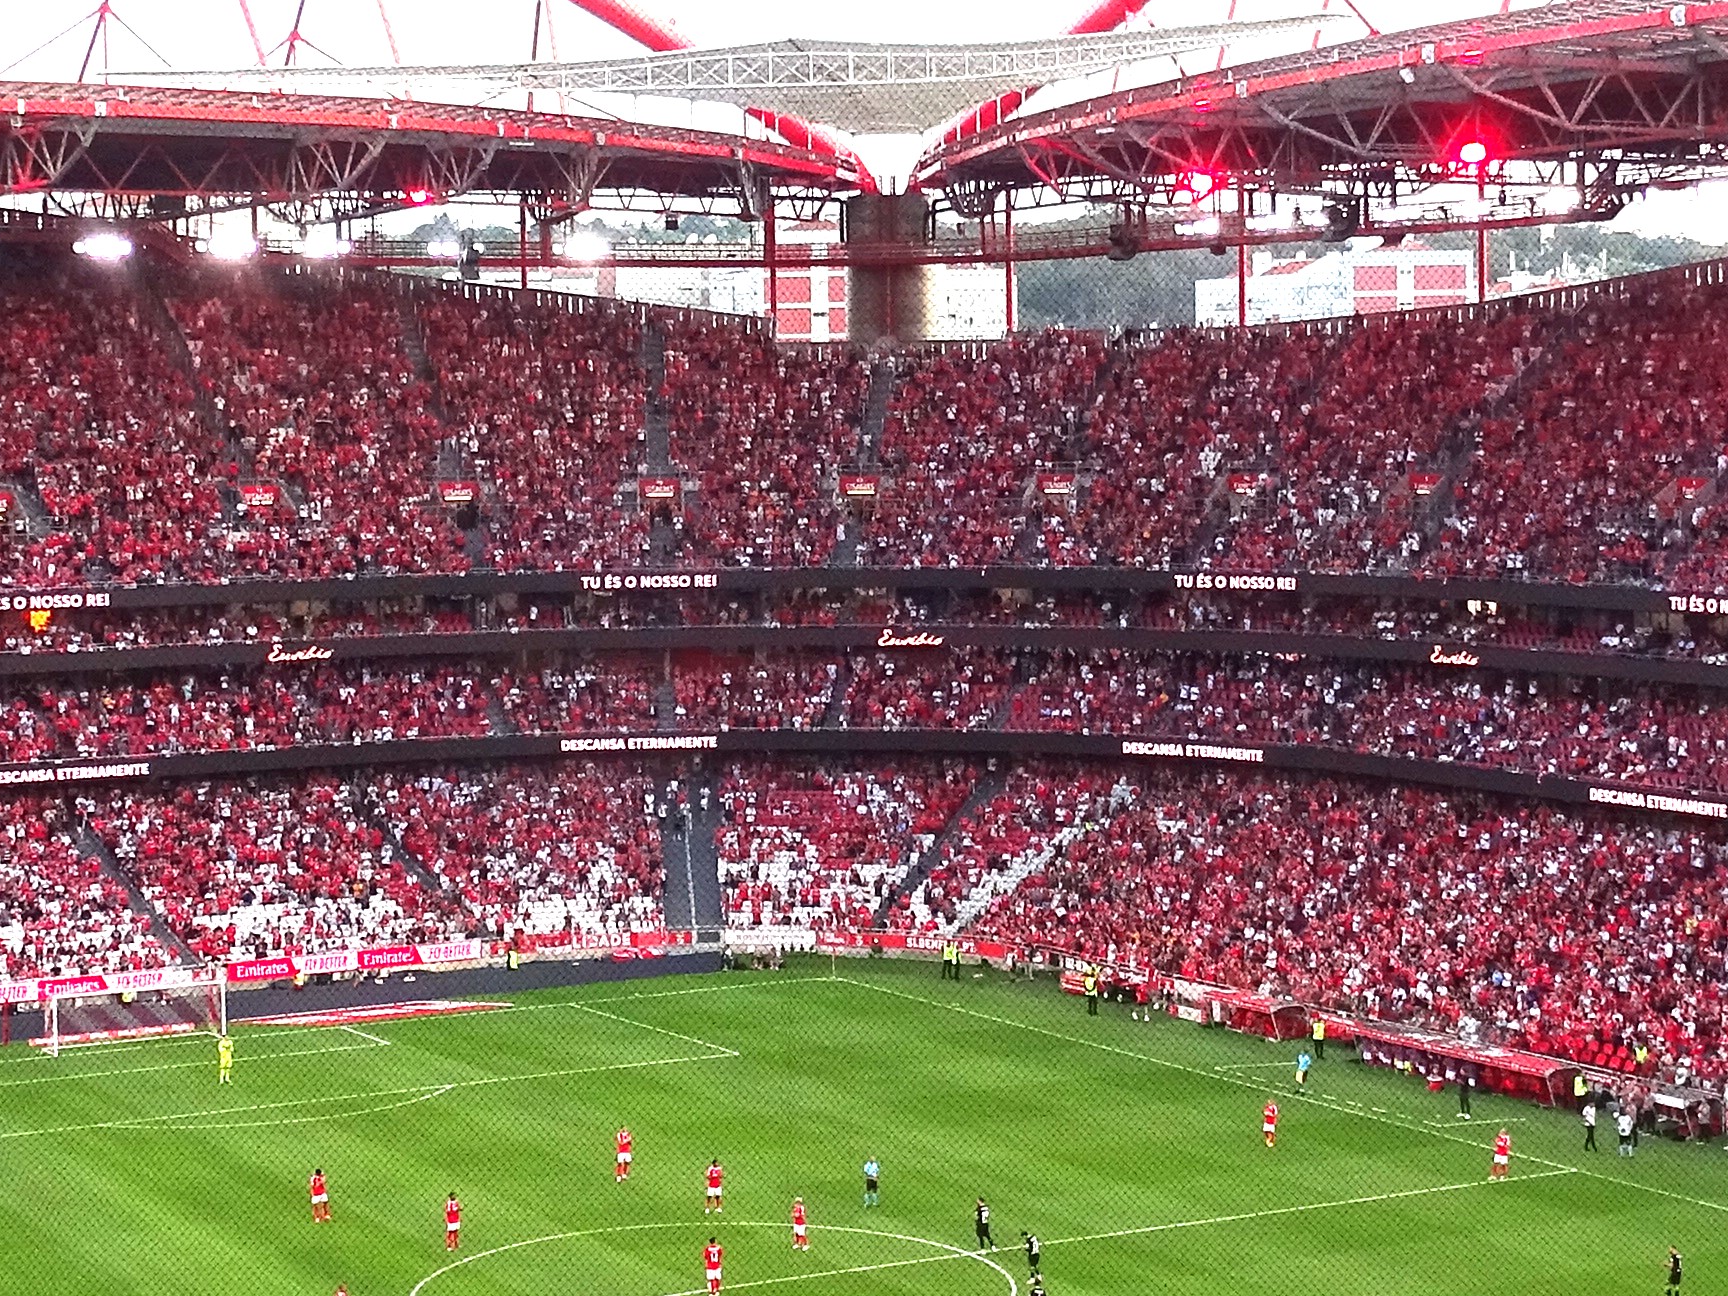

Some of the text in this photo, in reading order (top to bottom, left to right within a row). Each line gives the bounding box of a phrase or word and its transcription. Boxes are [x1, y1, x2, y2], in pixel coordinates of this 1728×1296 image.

[581, 576, 601, 589] TU
[624, 575, 637, 588] O
[640, 574, 691, 588] NOSSO
[694, 574, 717, 587] REI
[1174, 574, 1193, 588] TU
[1214, 575, 1227, 588] O
[1230, 576, 1275, 590] NOSSO
[1277, 577, 1296, 590] REI
[13, 596, 27, 609] O
[30, 594, 83, 608] NOSSO
[86, 593, 110, 606] REI
[1669, 596, 1687, 611] TU
[1706, 598, 1718, 613] O
[560, 738, 625, 751] DESCANSA
[1122, 741, 1183, 757] DESCANSA
[1589, 787, 1645, 807] DESCANSA
[236, 962, 289, 978] Emirates
